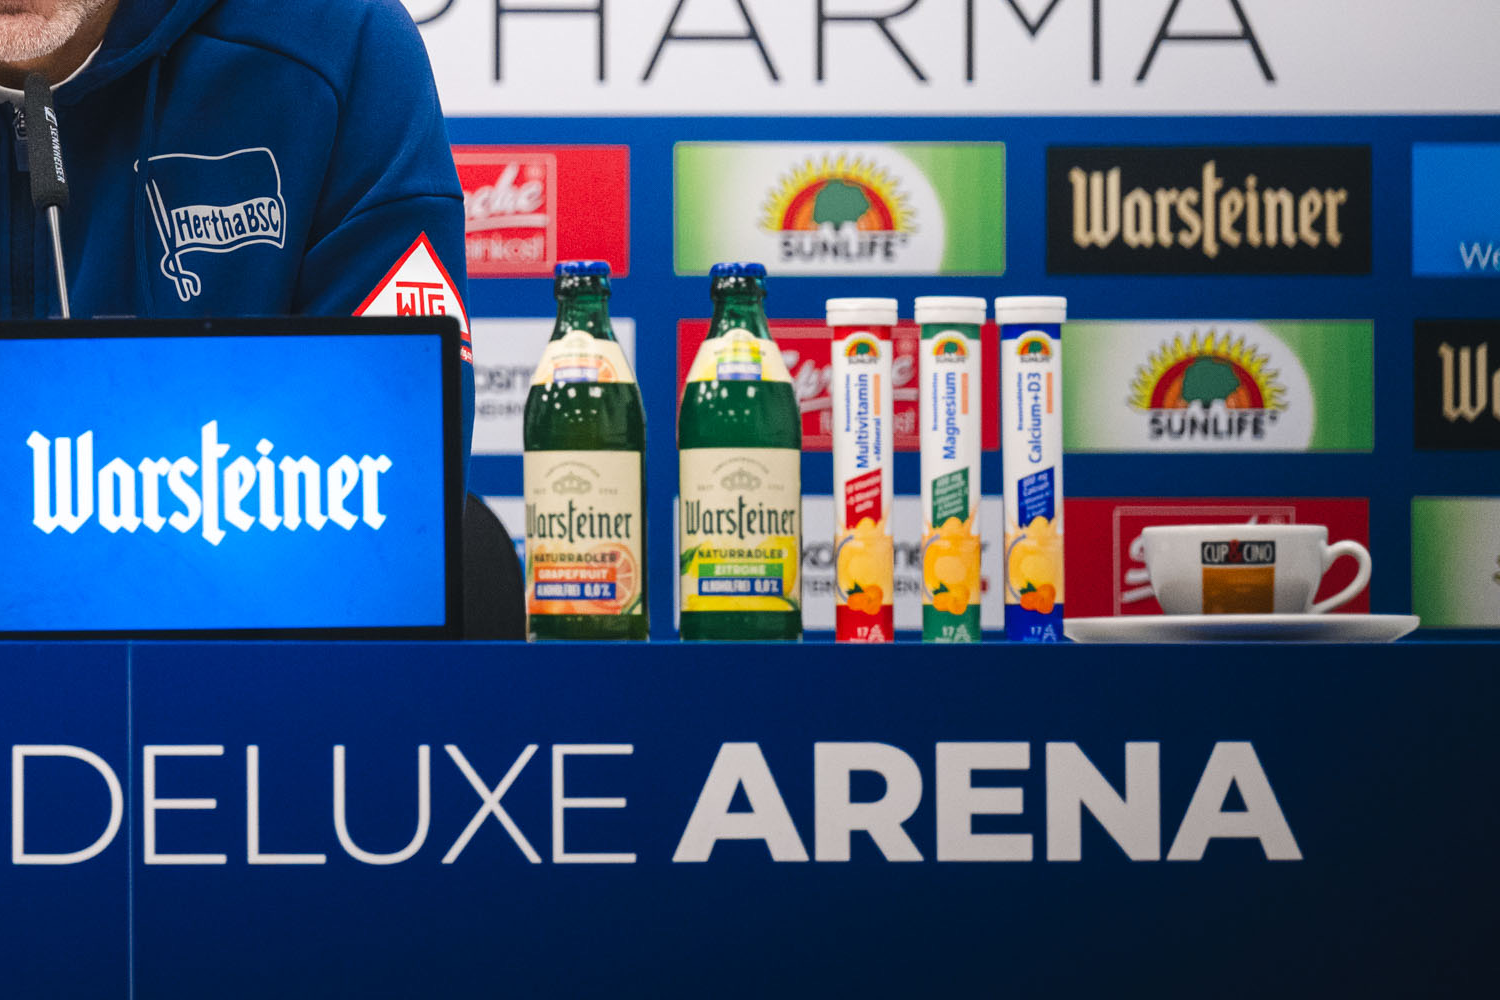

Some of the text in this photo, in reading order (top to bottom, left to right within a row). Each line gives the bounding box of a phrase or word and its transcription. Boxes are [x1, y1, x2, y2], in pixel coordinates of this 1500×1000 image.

[50, 125, 65, 184] SENNHEISER
[1070, 161, 1346, 257] Warsteiner
[781, 237, 894, 262] SUNLIFE
[855, 373, 869, 469] Multivitamin
[942, 372, 960, 460] Magnesium
[1147, 412, 1266, 440] SUNLIFE
[27, 420, 392, 546] Warsteiner
[686, 495, 795, 540] Warsteiner
[534, 552, 617, 563] NATURRADLER
[698, 549, 784, 559] NATURRADLER
[12, 744, 636, 865] DELUXE
[672, 742, 1302, 863] ARENA
